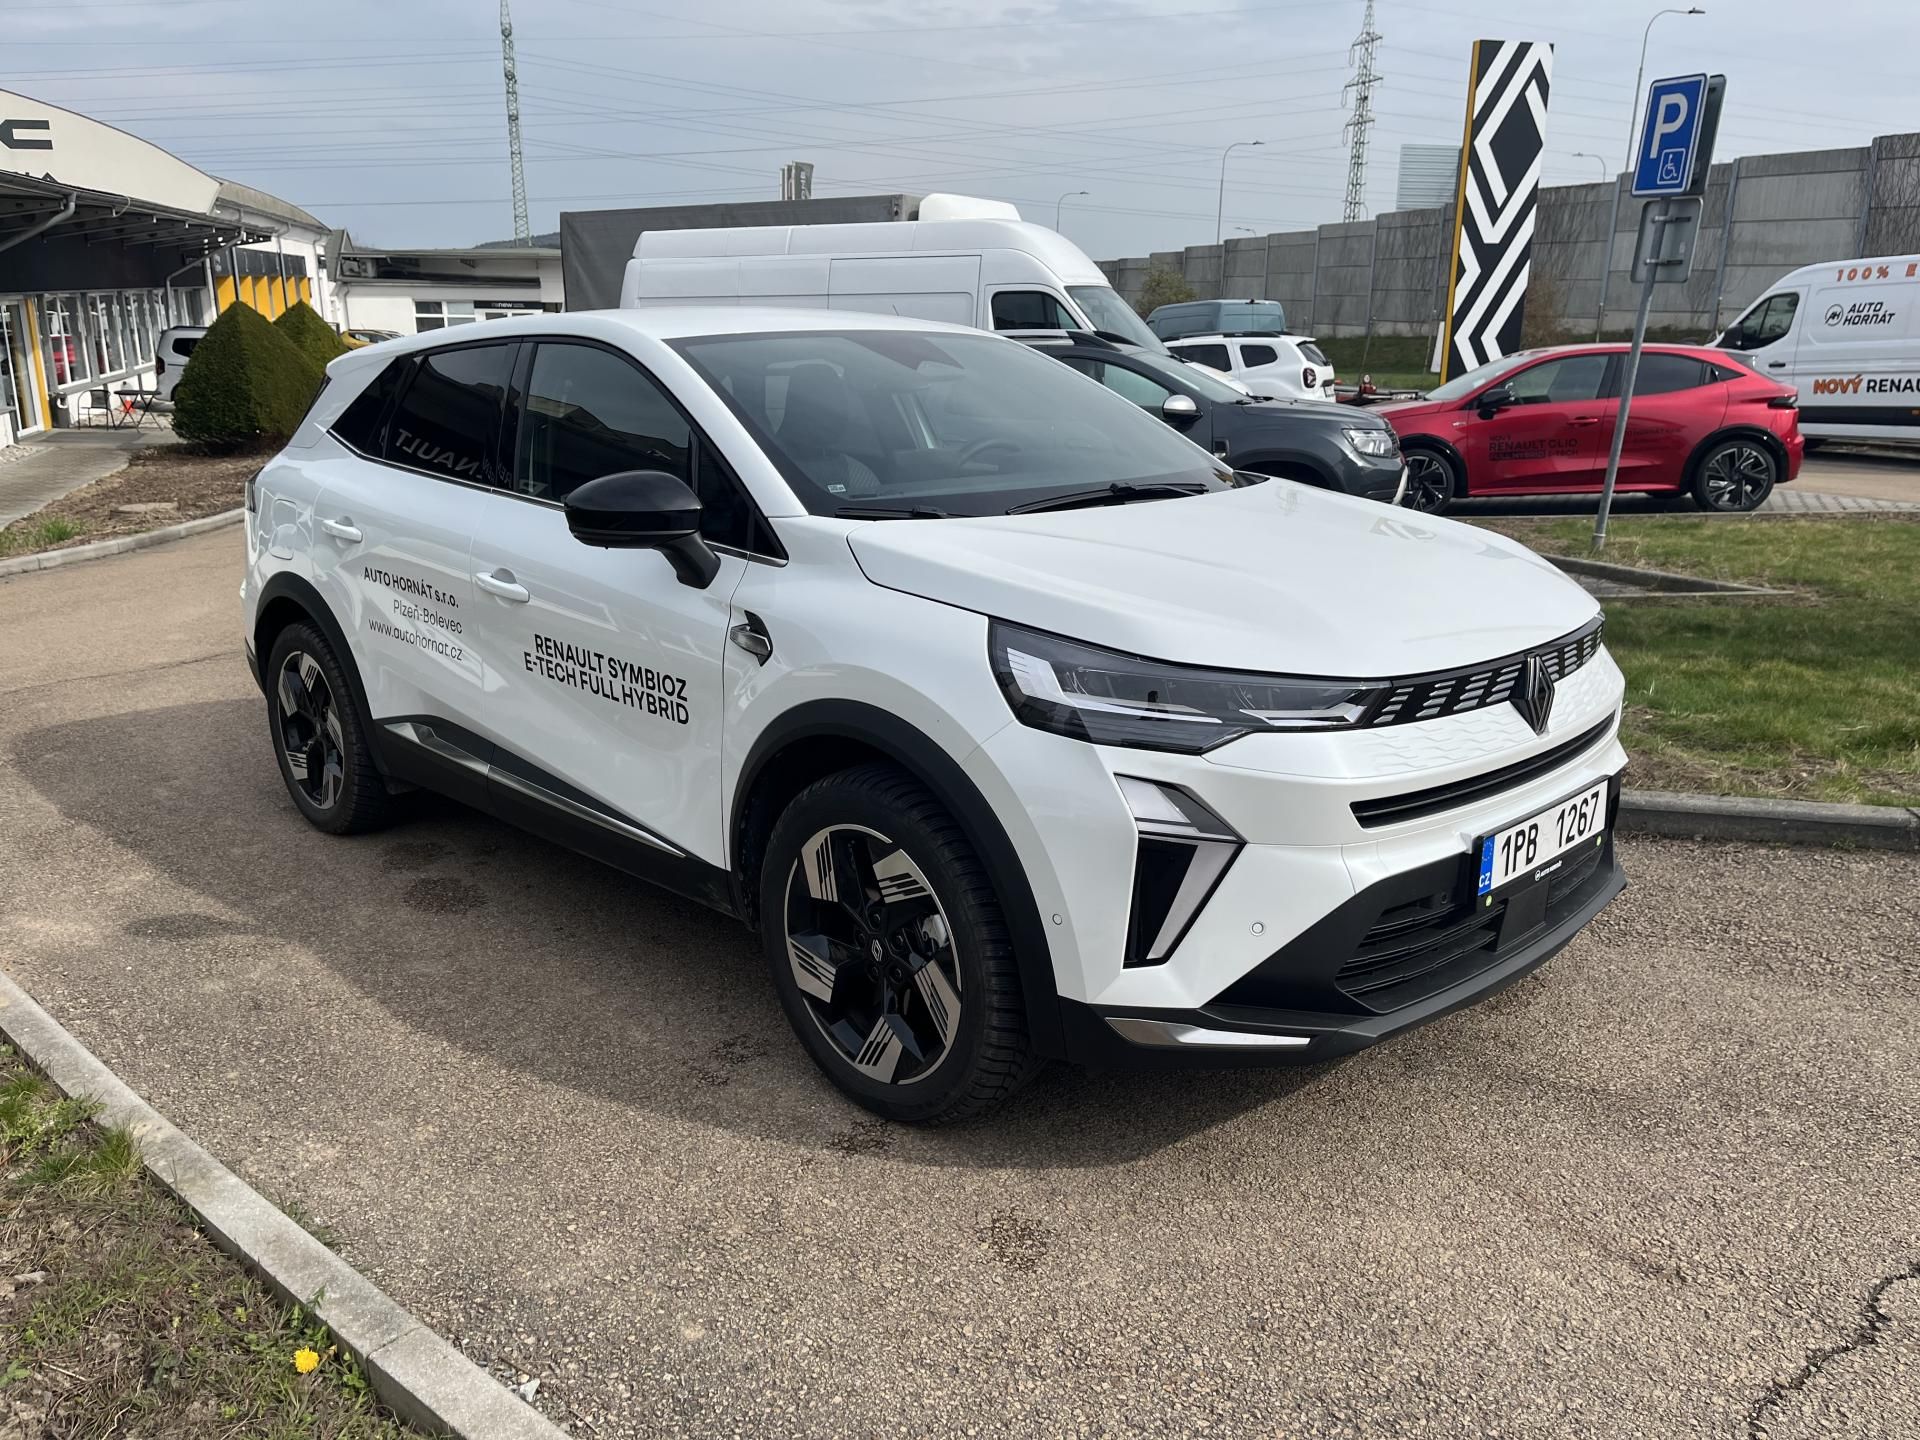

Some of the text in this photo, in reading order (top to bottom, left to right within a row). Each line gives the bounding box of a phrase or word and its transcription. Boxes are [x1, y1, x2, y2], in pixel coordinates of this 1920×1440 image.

[1649, 92, 1688, 159] P
[1836, 265, 1889, 282] 100%
[1847, 301, 1884, 314] AUTO
[1813, 373, 1863, 394] NOVÝ
[1489, 438, 1578, 452] RENAULT CLIO
[363, 566, 460, 608] AUTO HORNÁT s.r.o.
[393, 599, 463, 634] Plzeň-Bolevec
[368, 618, 463, 661] www.autohornat.cz
[523, 651, 690, 725] E-TECH FULL HYBRID
[534, 633, 688, 702] RENAULT SYMBIOZ
[1478, 790, 1600, 888] CZ 1PB 1267
